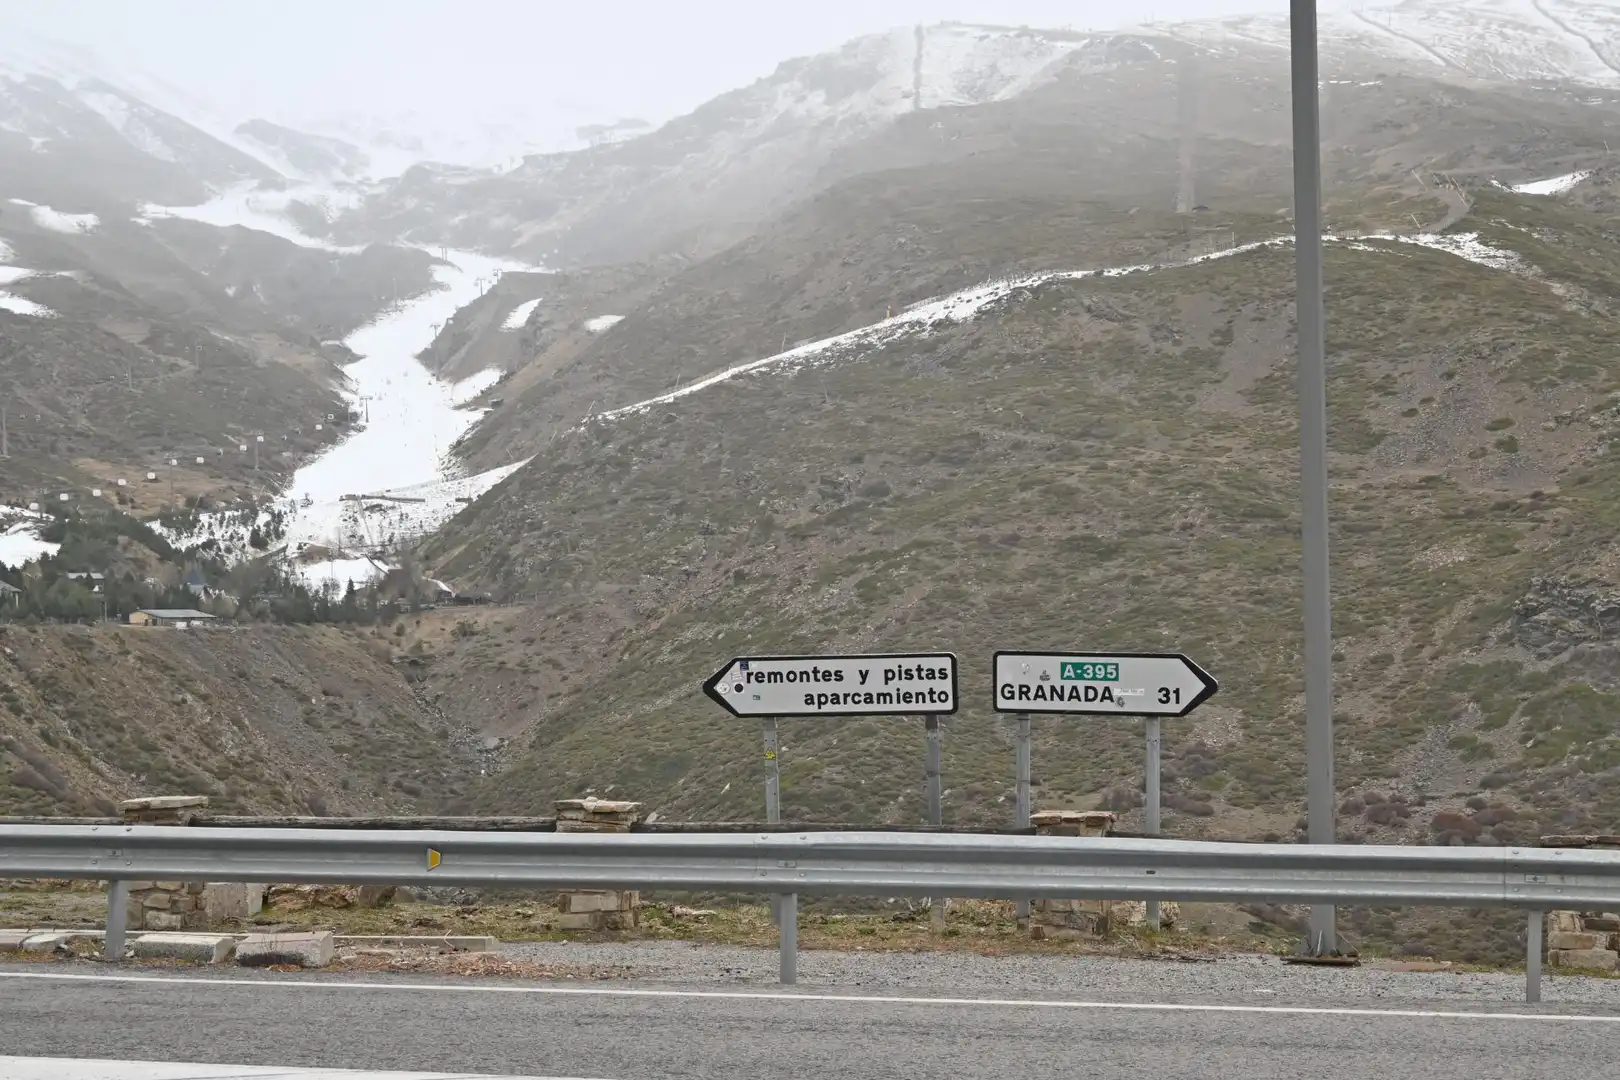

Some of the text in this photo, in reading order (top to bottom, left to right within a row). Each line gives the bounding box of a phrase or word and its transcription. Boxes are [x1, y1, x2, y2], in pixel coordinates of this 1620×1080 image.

[745, 664, 949, 686] remontes y pistas
[1062, 664, 1118, 680] A-395
[803, 687, 950, 710] aparcamiento
[1000, 683, 1116, 703] GRANADA
[1157, 686, 1182, 705] 31
